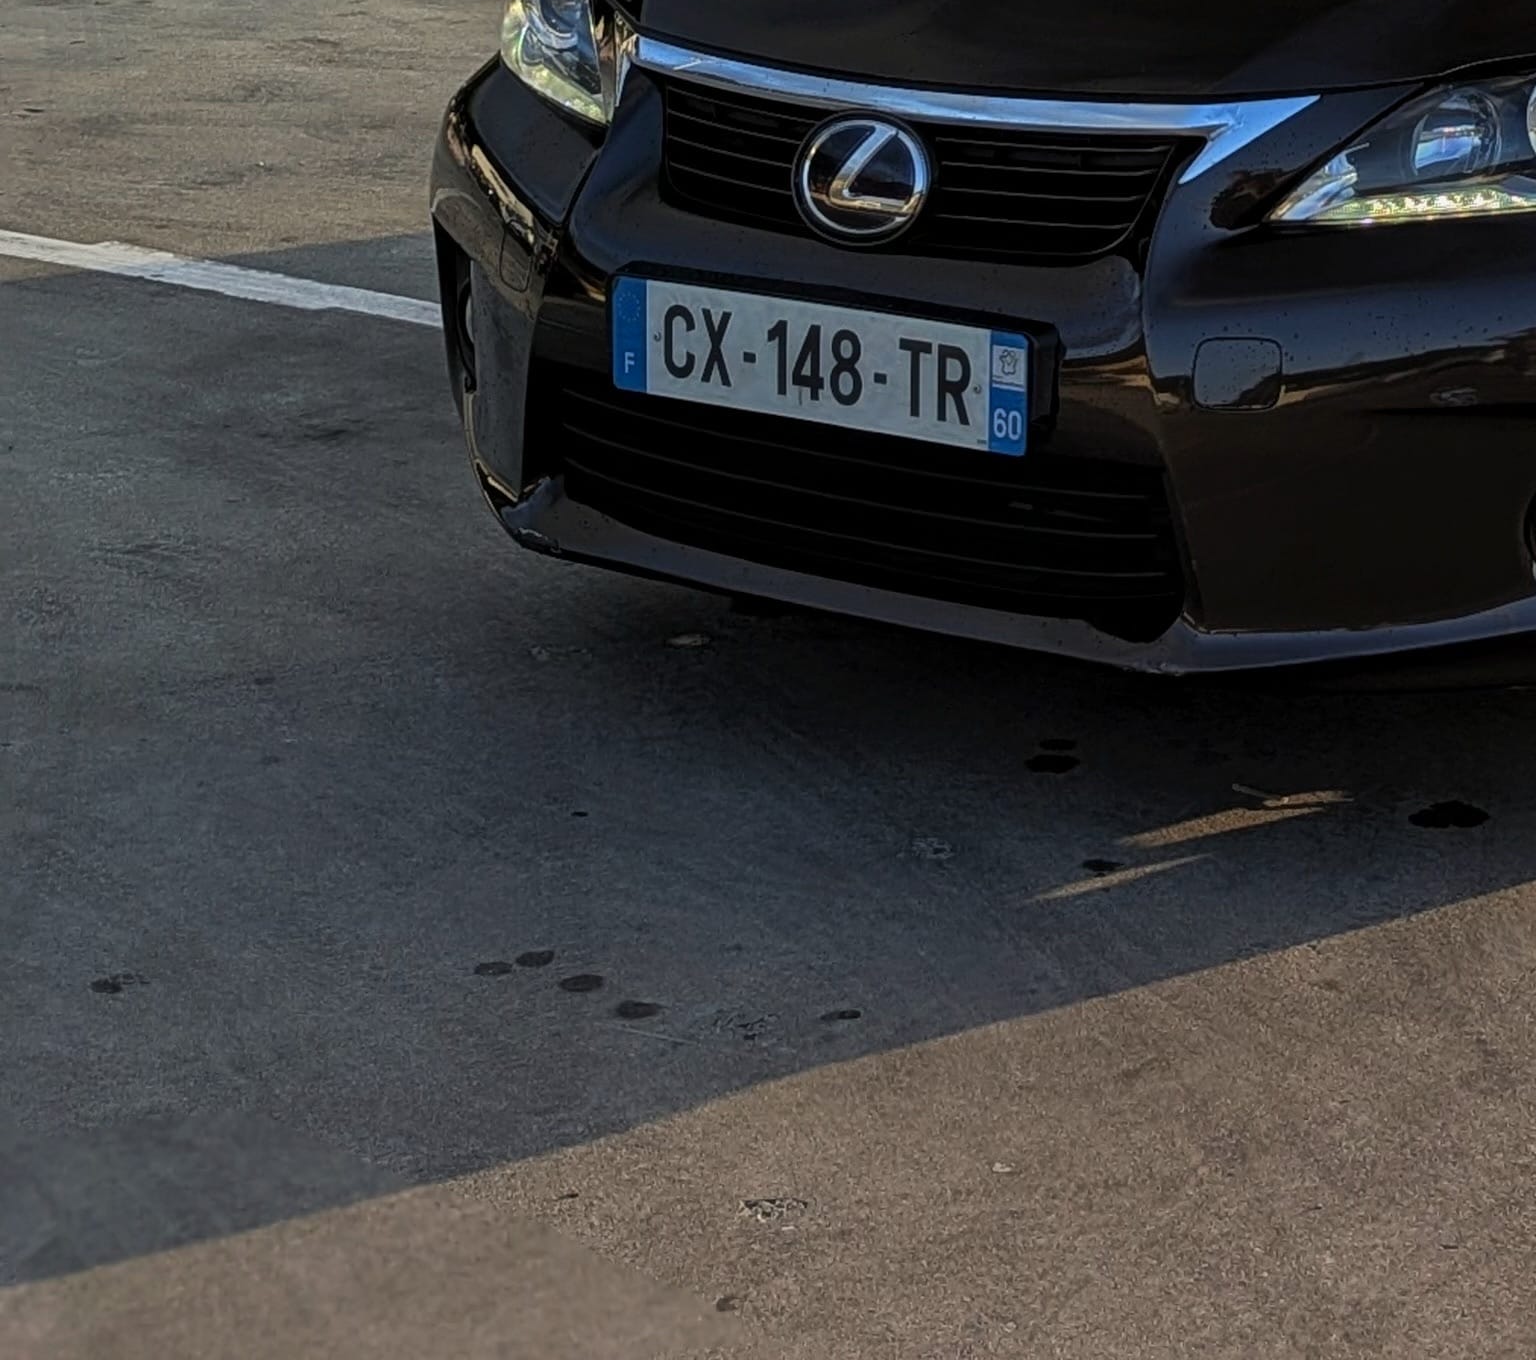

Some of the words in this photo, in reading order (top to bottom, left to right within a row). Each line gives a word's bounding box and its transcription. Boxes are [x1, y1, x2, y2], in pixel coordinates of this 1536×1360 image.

[624, 351, 635, 374] F
[664, 304, 971, 426] CX-148-TR
[993, 408, 1022, 441] 60
